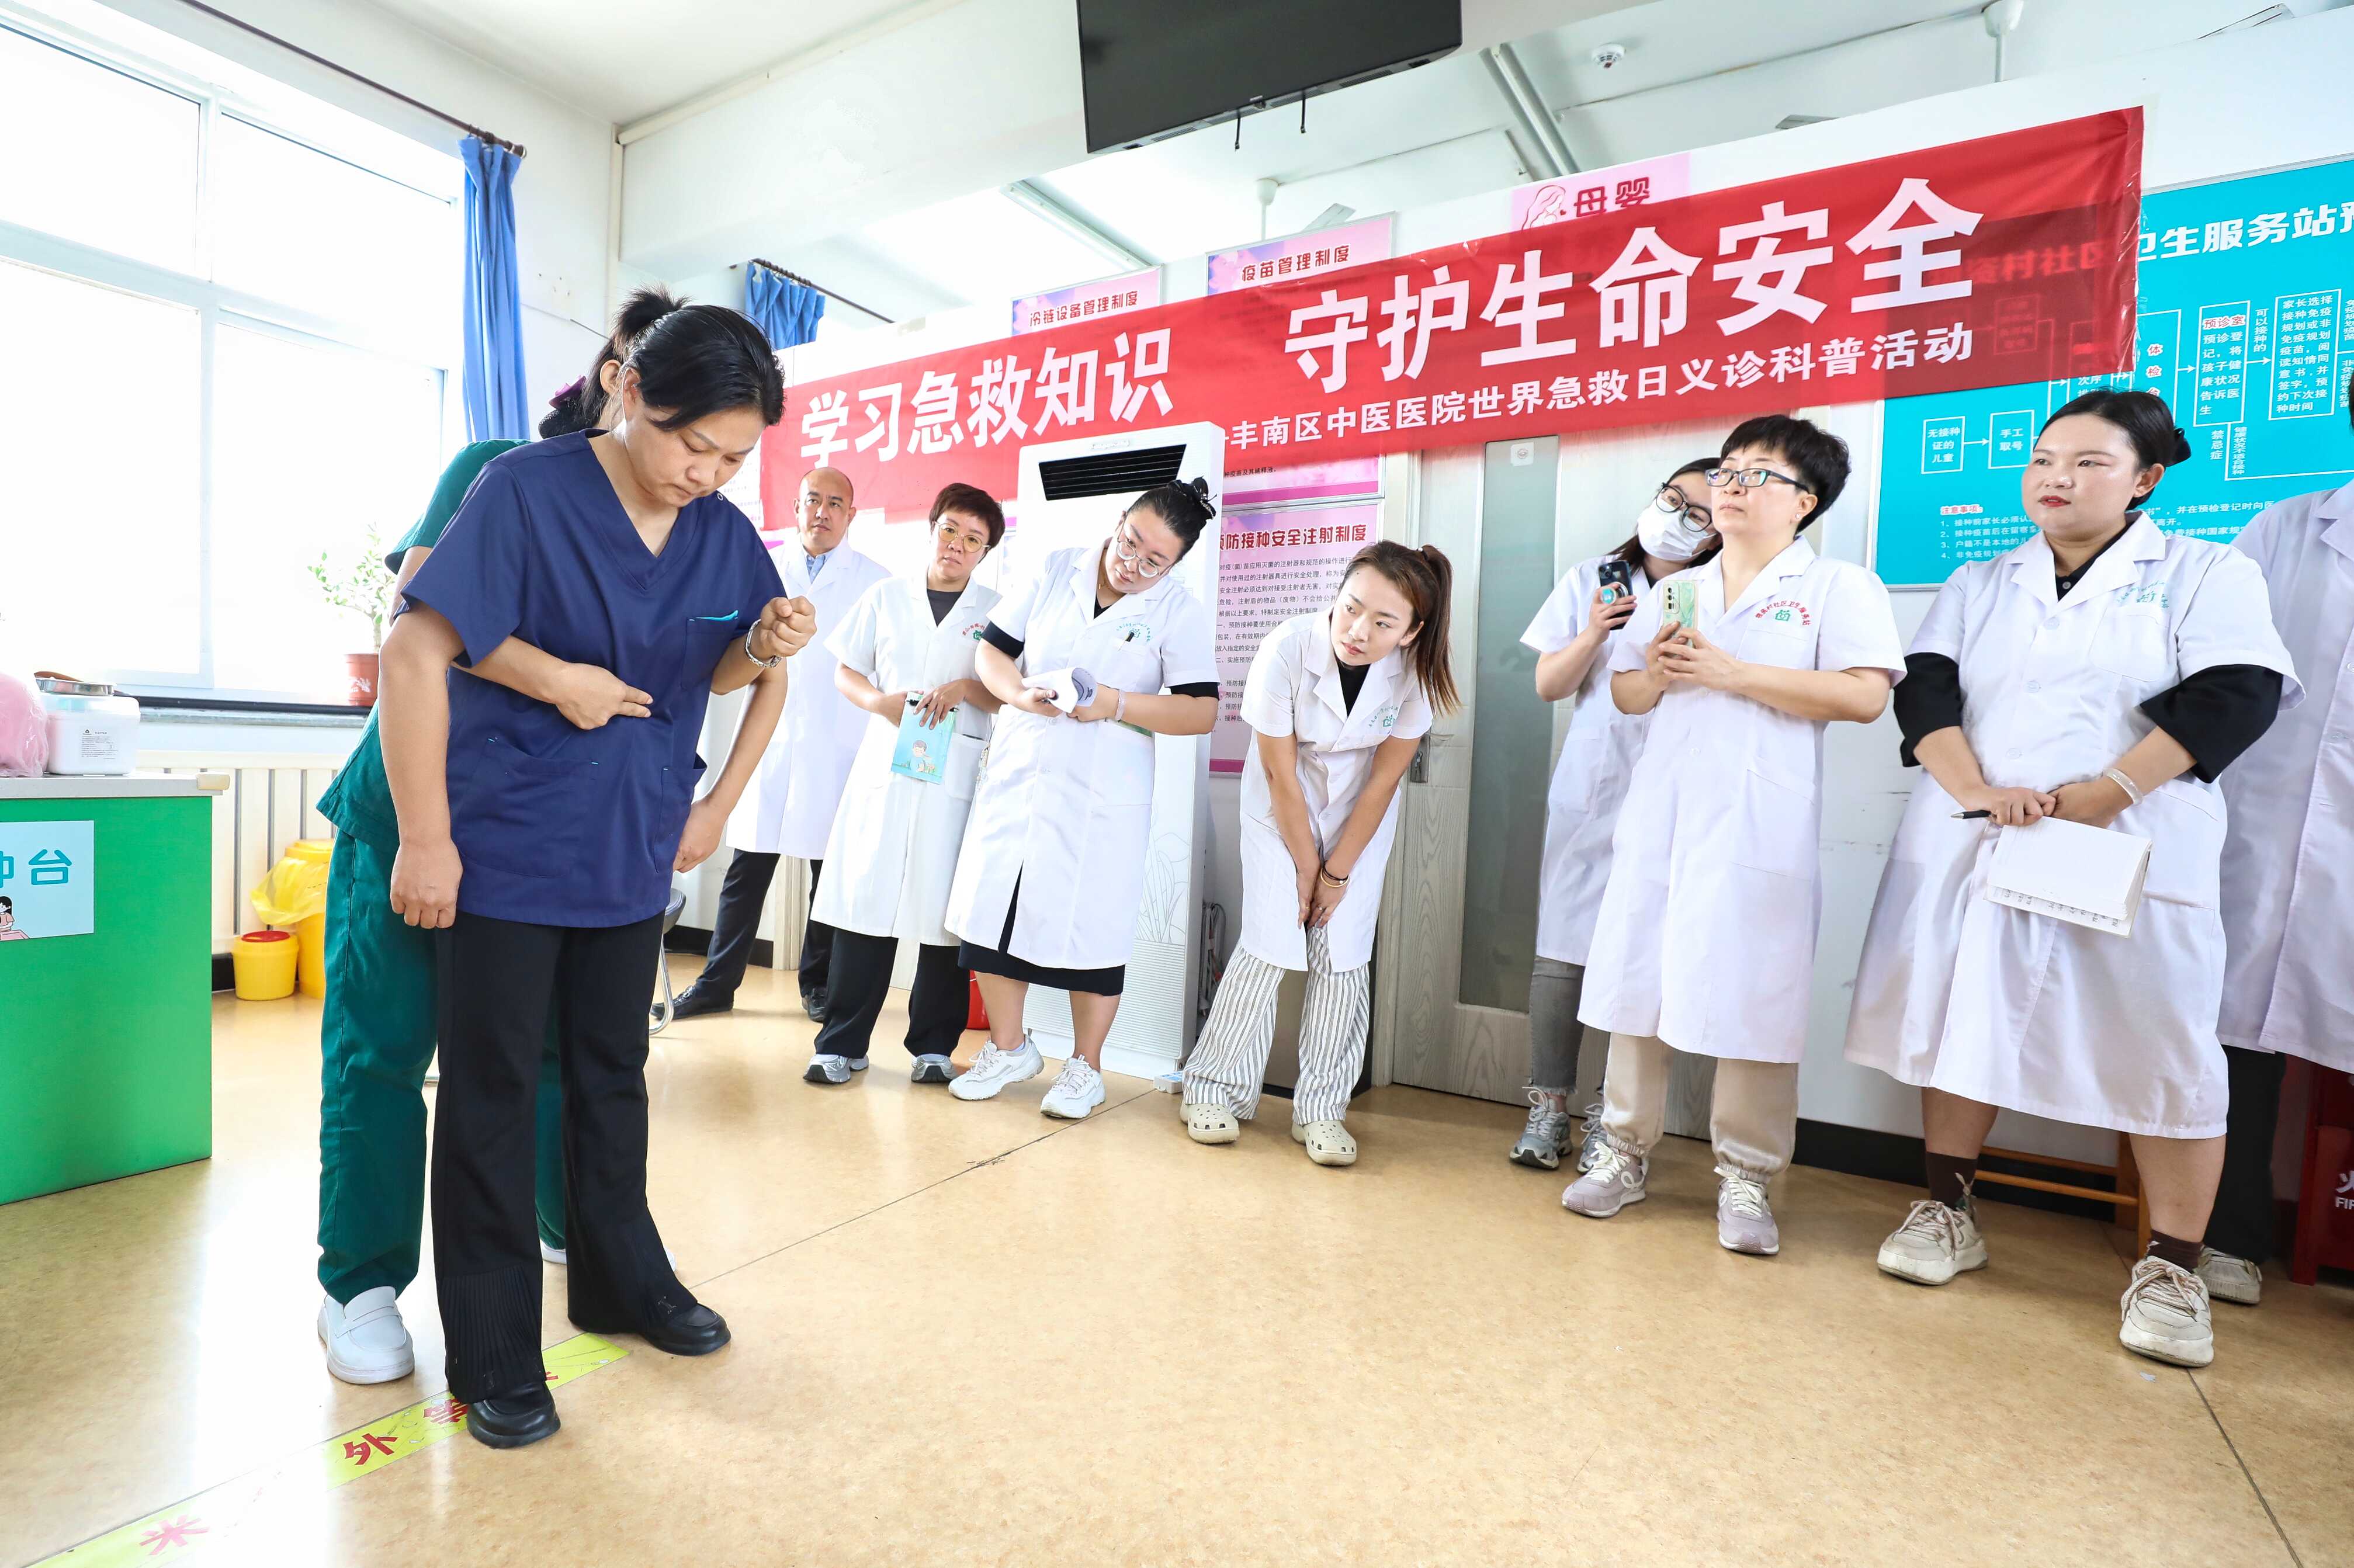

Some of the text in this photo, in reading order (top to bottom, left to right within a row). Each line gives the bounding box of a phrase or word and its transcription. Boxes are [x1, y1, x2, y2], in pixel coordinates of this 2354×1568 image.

[1573, 176, 1650, 217] 母婴
[1242, 245, 1349, 282] 疫苗管理制度
[1029, 290, 1138, 327] 冷链设备管理制度
[2282, 294, 2333, 310] 家长选择
[2282, 307, 2333, 321] 接种免疫
[801, 178, 1984, 468] 学习急救知识 守护生命安全
[2203, 315, 2245, 329] 预诊室
[2281, 318, 2332, 333] 规划或非
[2253, 308, 2269, 353] 可以接种的
[2280, 329, 2331, 345] 免疫规划
[2203, 331, 2244, 345] 预诊登
[2202, 345, 2242, 359] 记，将
[2202, 359, 2242, 373] 孩子健
[2279, 354, 2329, 368] 读知情同
[1225, 322, 1972, 450] 丰南区中医医院世界急救日义诊科普活动
[2200, 374, 2241, 387] 康状况
[2200, 388, 2240, 402] 告诉医
[2277, 389, 2328, 403] 约下次接
[2199, 405, 2212, 415] 生
[2276, 402, 2314, 414] 种时间
[1927, 426, 1961, 438] 无接种
[2000, 428, 2024, 439] 手工
[1932, 440, 1955, 451] 证的
[1999, 442, 2024, 452] 取号
[2210, 429, 2224, 460] 禁忌症
[1931, 453, 1954, 463] 儿童
[1941, 515, 2031, 527] 1、接种前家长必须认
